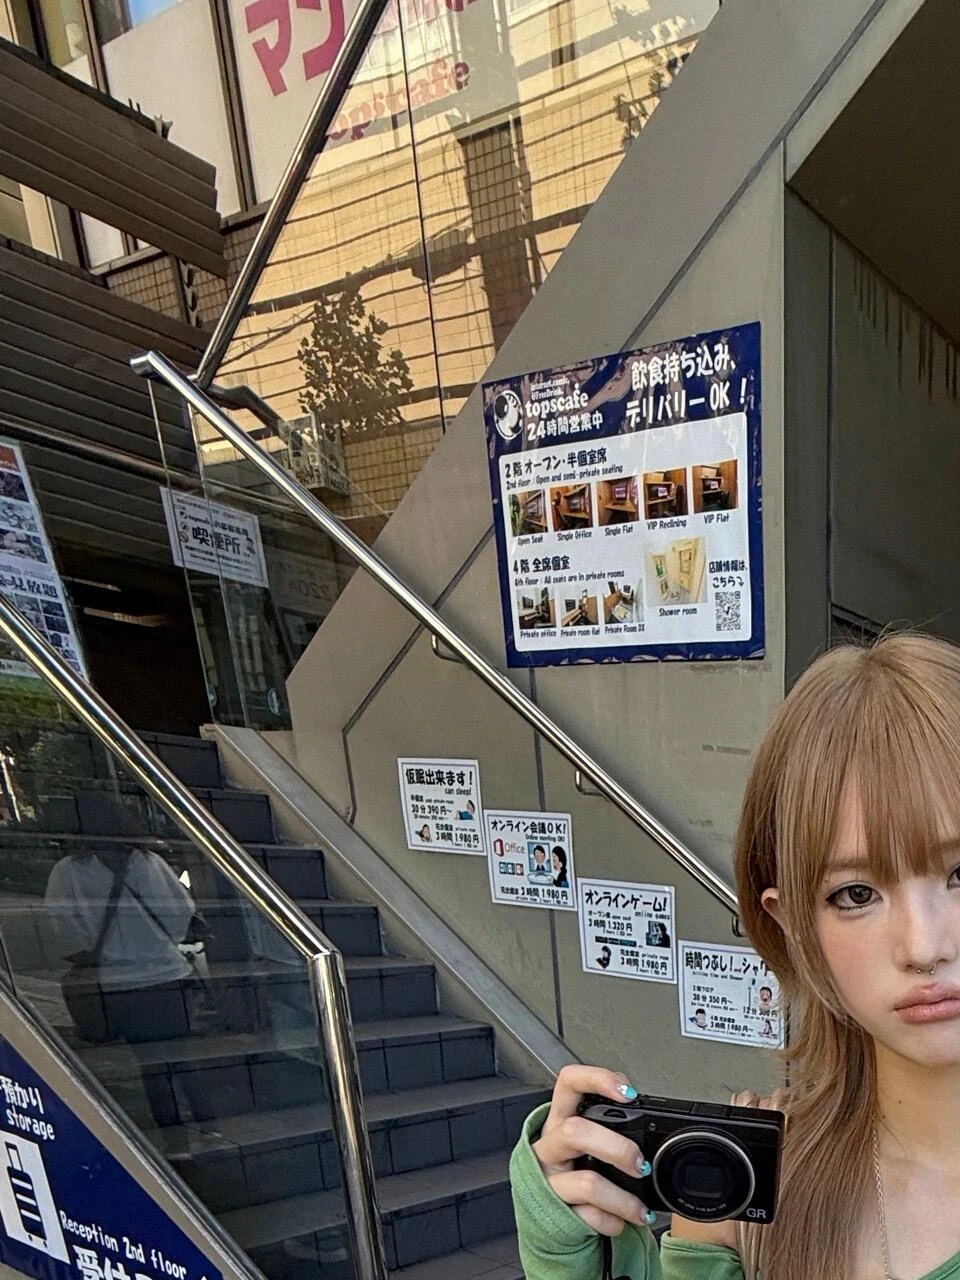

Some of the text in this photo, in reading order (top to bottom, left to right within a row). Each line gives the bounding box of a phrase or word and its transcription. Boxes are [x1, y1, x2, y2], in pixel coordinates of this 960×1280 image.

[527, 411, 604, 441] 24時間営業中
[536, 475, 550, 485] Open
[551, 473, 562, 482] and
[647, 518, 687, 530] VIP Reclining
[704, 513, 730, 524] VIP Flat
[604, 525, 634, 537] Single Flat
[532, 555, 571, 573] 全席個室
[607, 570, 625, 579] rooms
[712, 575, 736, 588] こちら
[659, 607, 698, 617] Shower room
[504, 842, 525, 854] Office
[6, 1104, 56, 1141] storage
[746, 1207, 767, 1219] GR
[60, 1209, 119, 1254] Reception
[122, 1236, 144, 1264] 2nd
